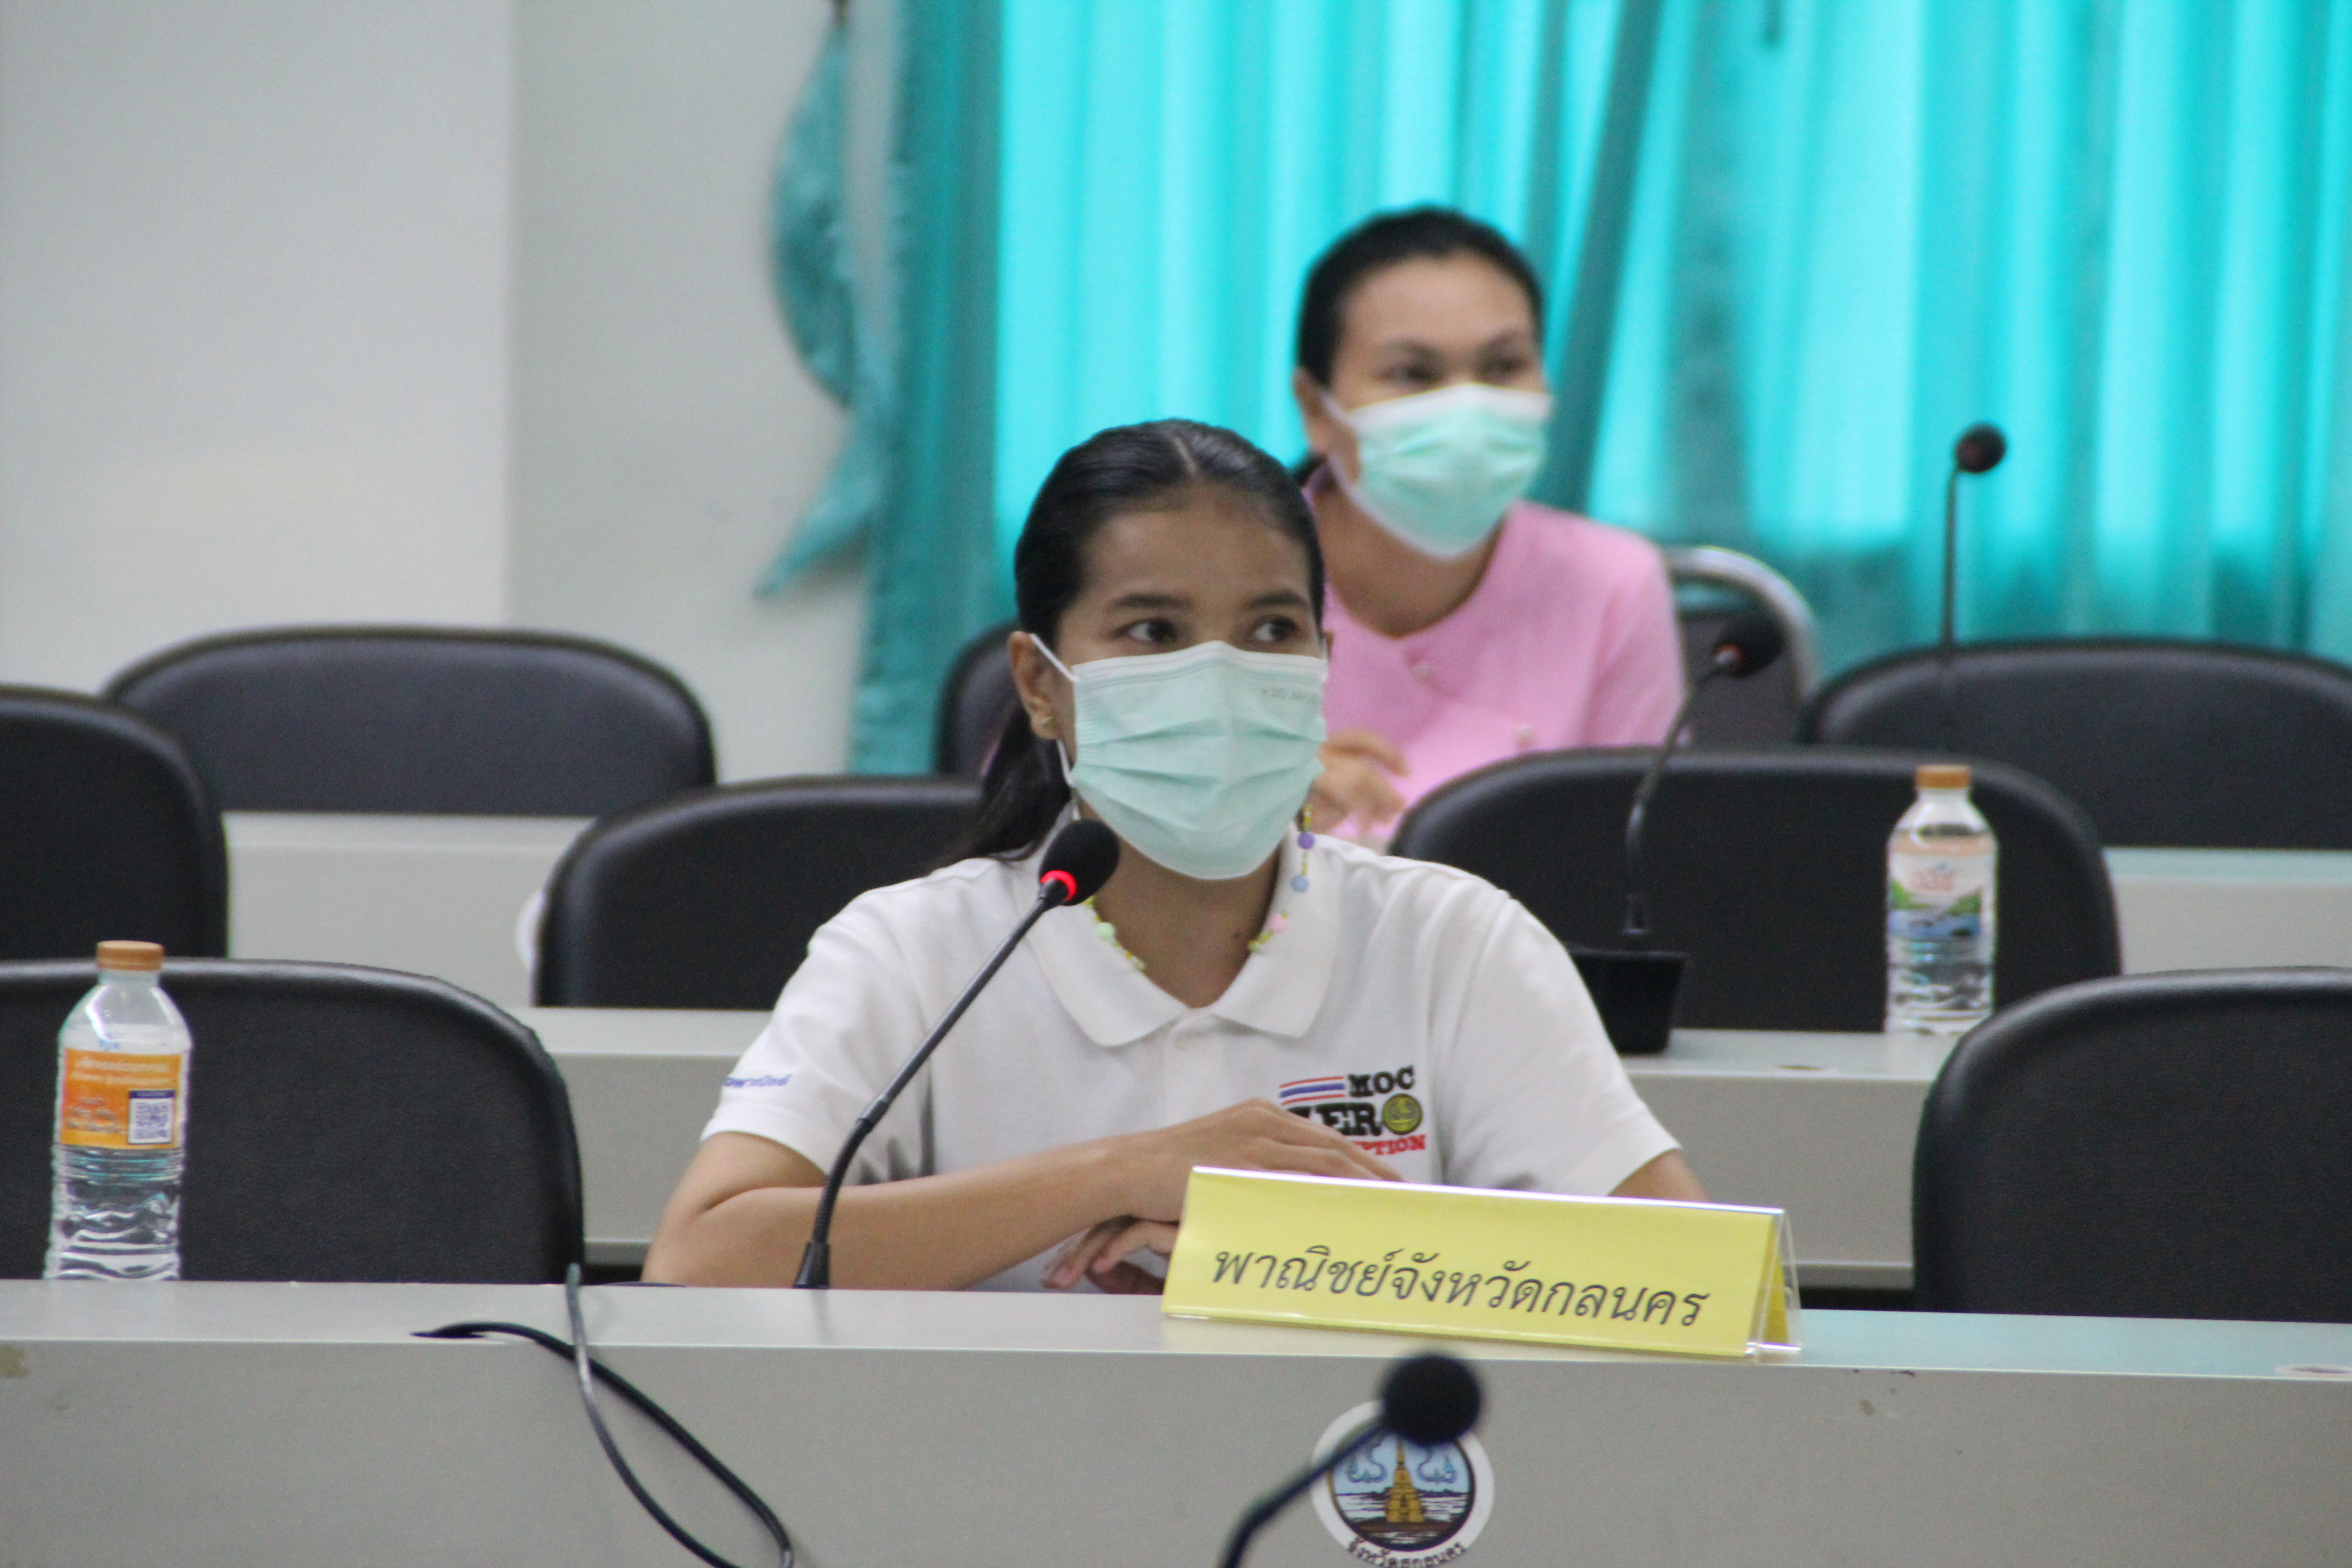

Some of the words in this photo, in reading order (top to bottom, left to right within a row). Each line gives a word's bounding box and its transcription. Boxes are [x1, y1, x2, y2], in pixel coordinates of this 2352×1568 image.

[1348, 1065, 1415, 1097] MOC
[1212, 1245, 1710, 1327] พาณิชย์จังหวัดกลนคร
